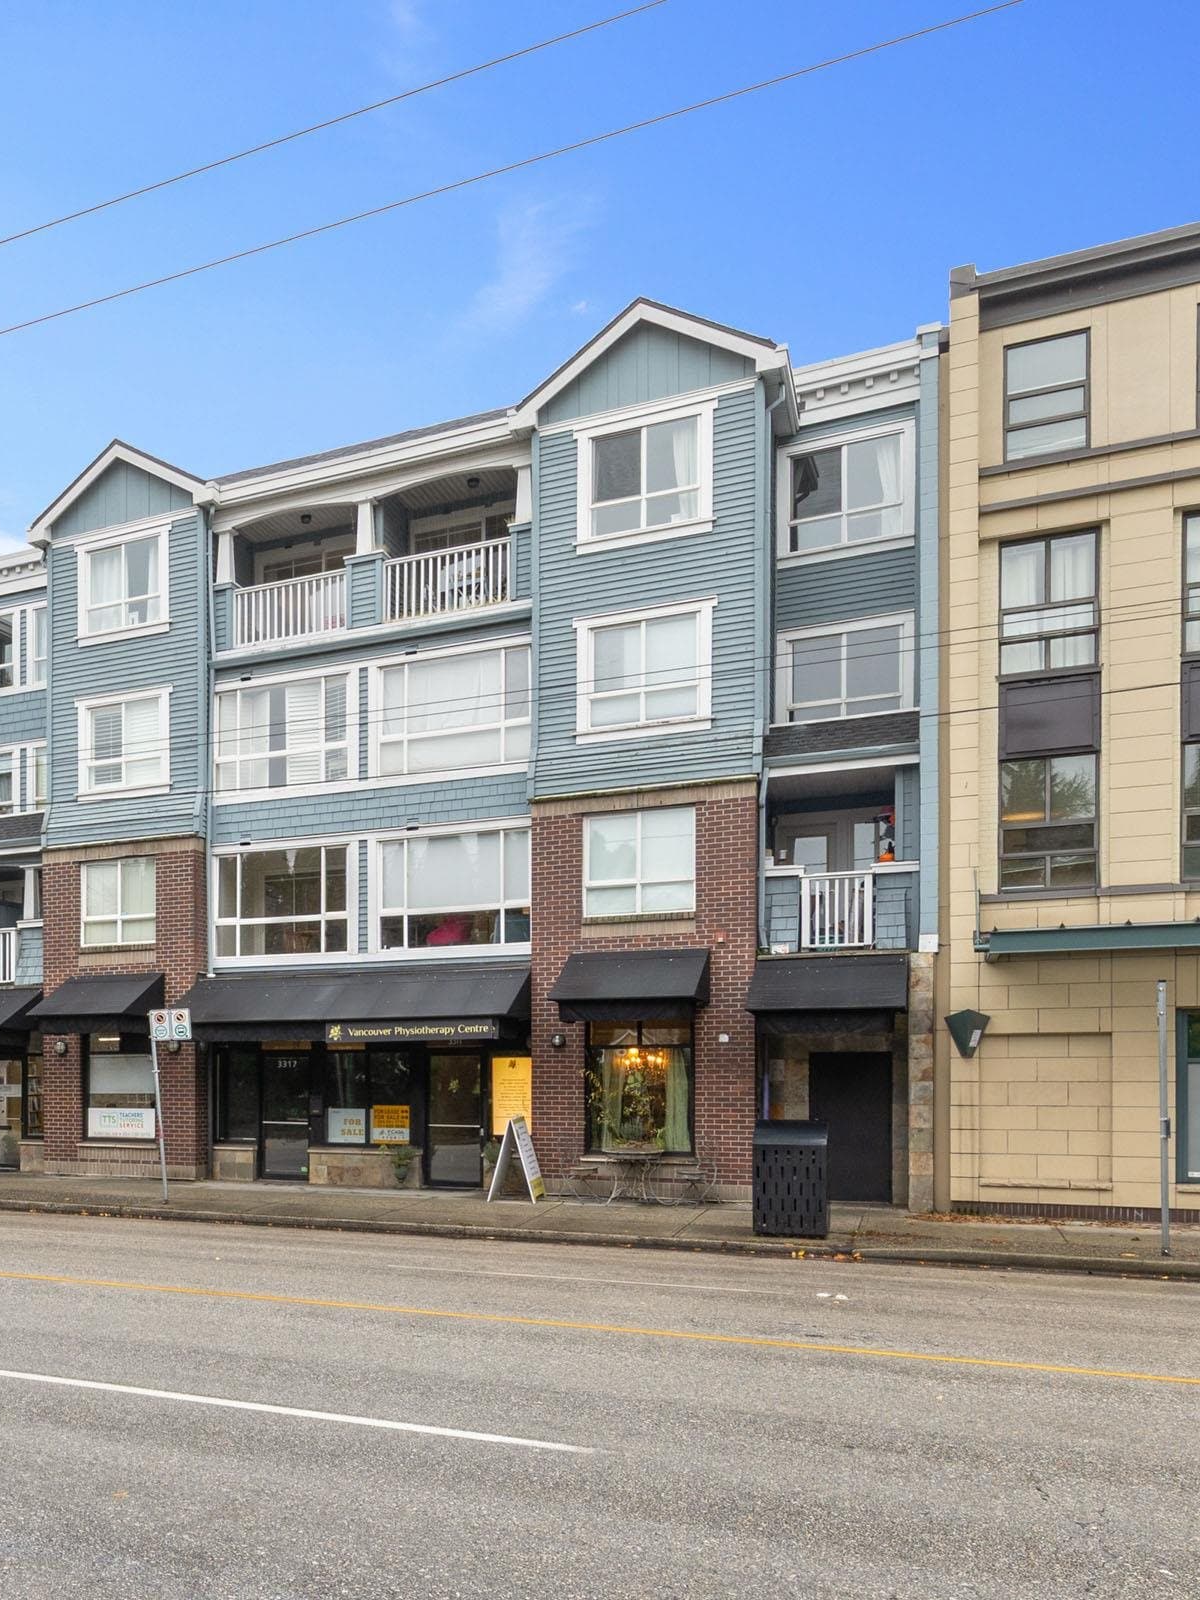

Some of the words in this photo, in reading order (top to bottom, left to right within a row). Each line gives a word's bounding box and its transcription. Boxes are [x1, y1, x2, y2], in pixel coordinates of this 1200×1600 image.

[347, 1027, 392, 1037] Vancouver
[394, 1025, 455, 1038] Physiotherapy
[457, 1023, 489, 1033] Centre
[277, 1060, 298, 1068] 3317
[102, 1114, 117, 1124] TTS
[343, 1118, 362, 1126] FOR
[341, 1128, 364, 1136] SALE
